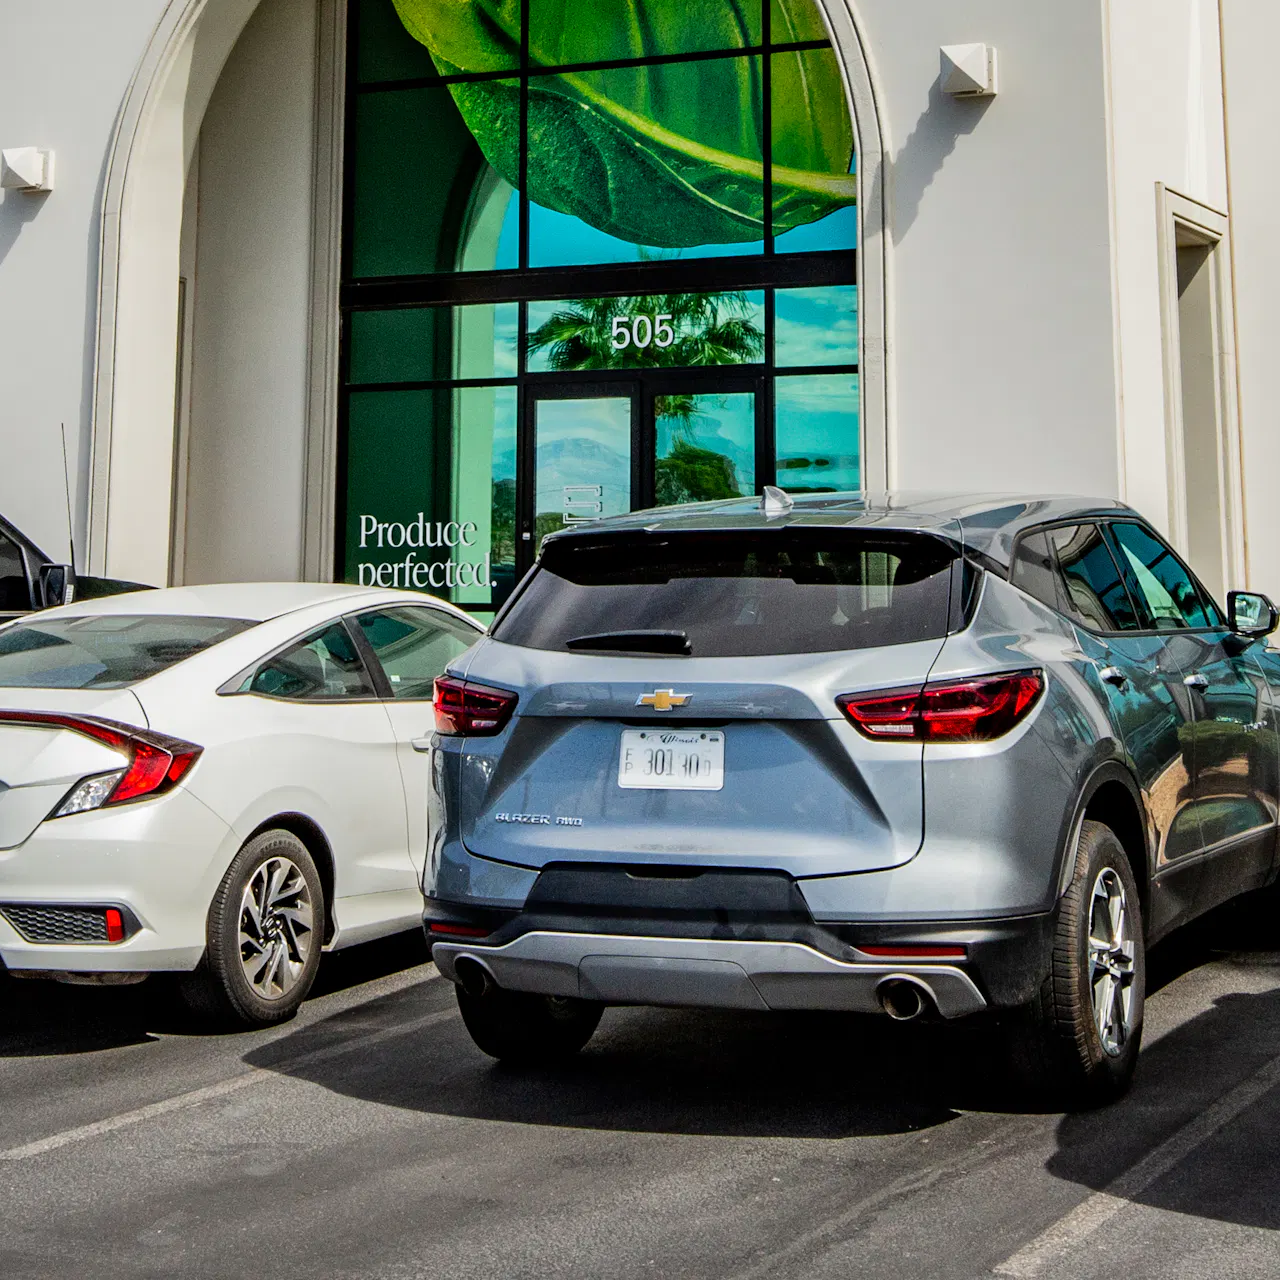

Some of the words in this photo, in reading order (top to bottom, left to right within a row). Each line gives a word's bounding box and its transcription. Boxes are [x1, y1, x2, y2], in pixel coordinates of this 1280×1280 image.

[611, 314, 674, 350] 505
[358, 512, 477, 548] Produce
[495, 812, 551, 826] BLAZER
[556, 816, 584, 827] AWD
